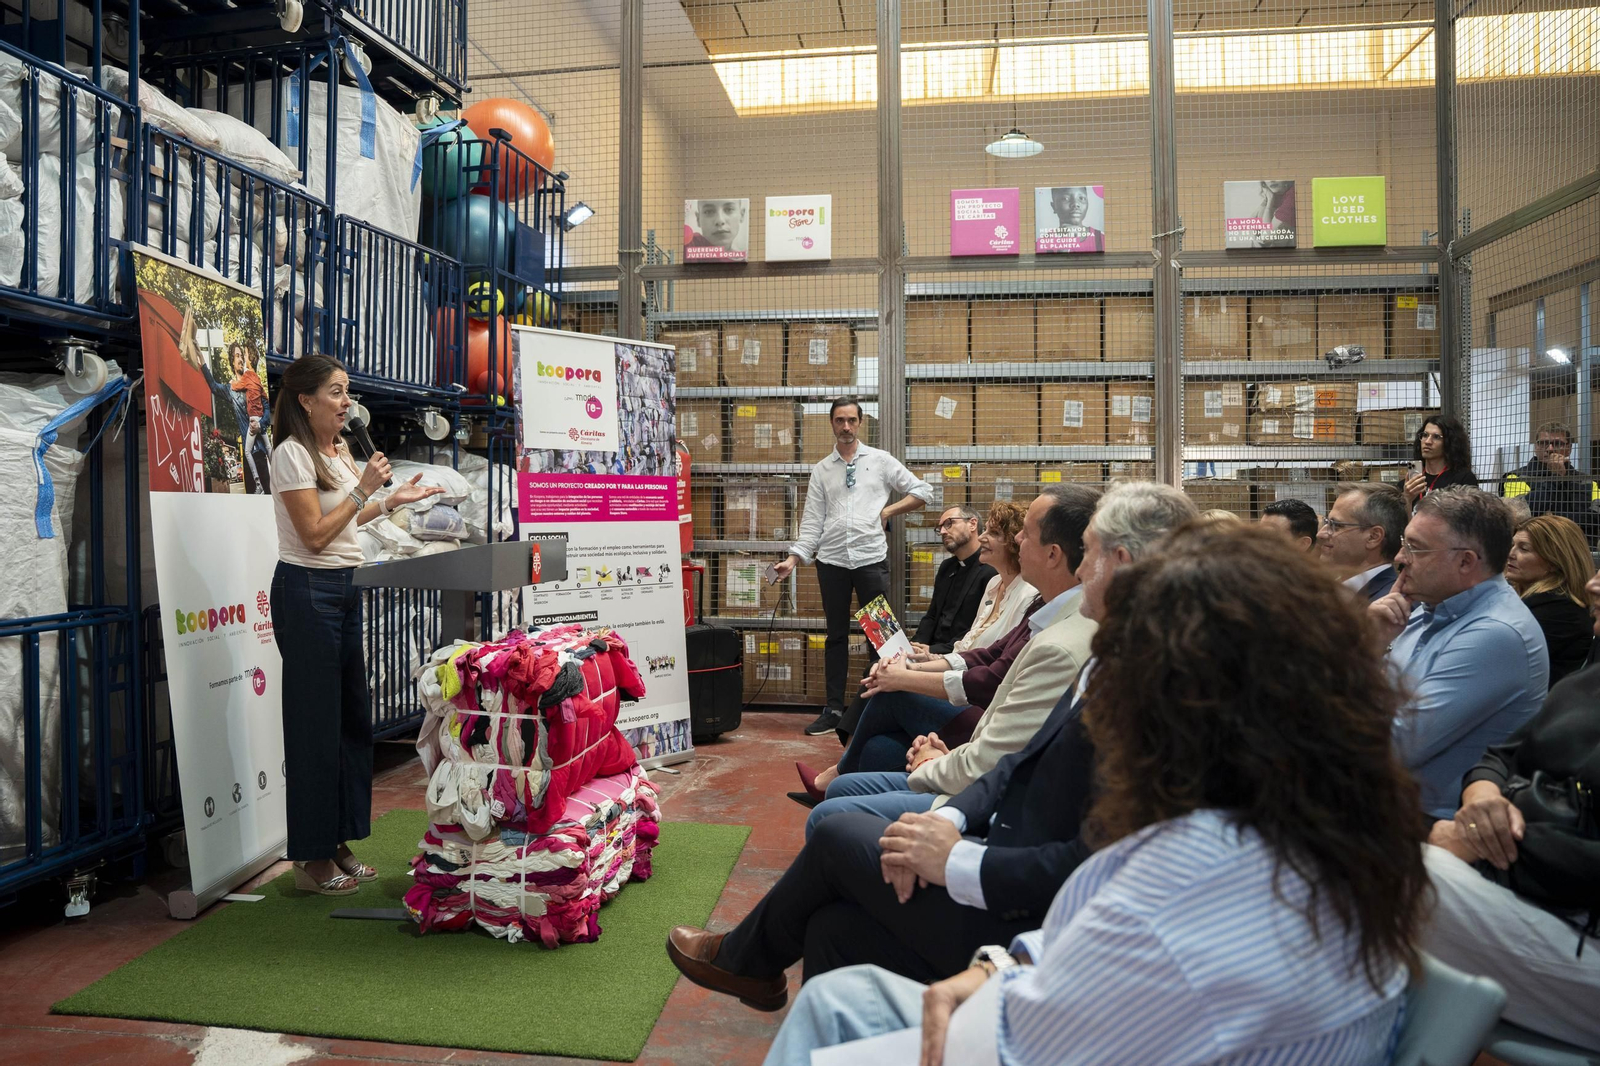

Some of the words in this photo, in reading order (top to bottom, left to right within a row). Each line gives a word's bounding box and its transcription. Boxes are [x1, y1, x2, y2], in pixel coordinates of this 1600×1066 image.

[1332, 196, 1364, 204] LOVE
[769, 208, 814, 217] koopera
[1333, 206, 1364, 214] USED
[788, 217, 814, 229] Store
[1321, 216, 1377, 225] CLOTHES
[537, 361, 602, 382] koopera
[575, 394, 597, 402] moda
[175, 604, 246, 635] koopera
[552, 613, 598, 622] MEDIOAMBIENTAL
[209, 679, 229, 689] Formamos
[229, 676, 238, 685] parte
[244, 665, 261, 678] moda
[614, 713, 659, 724] www.koopera.org
